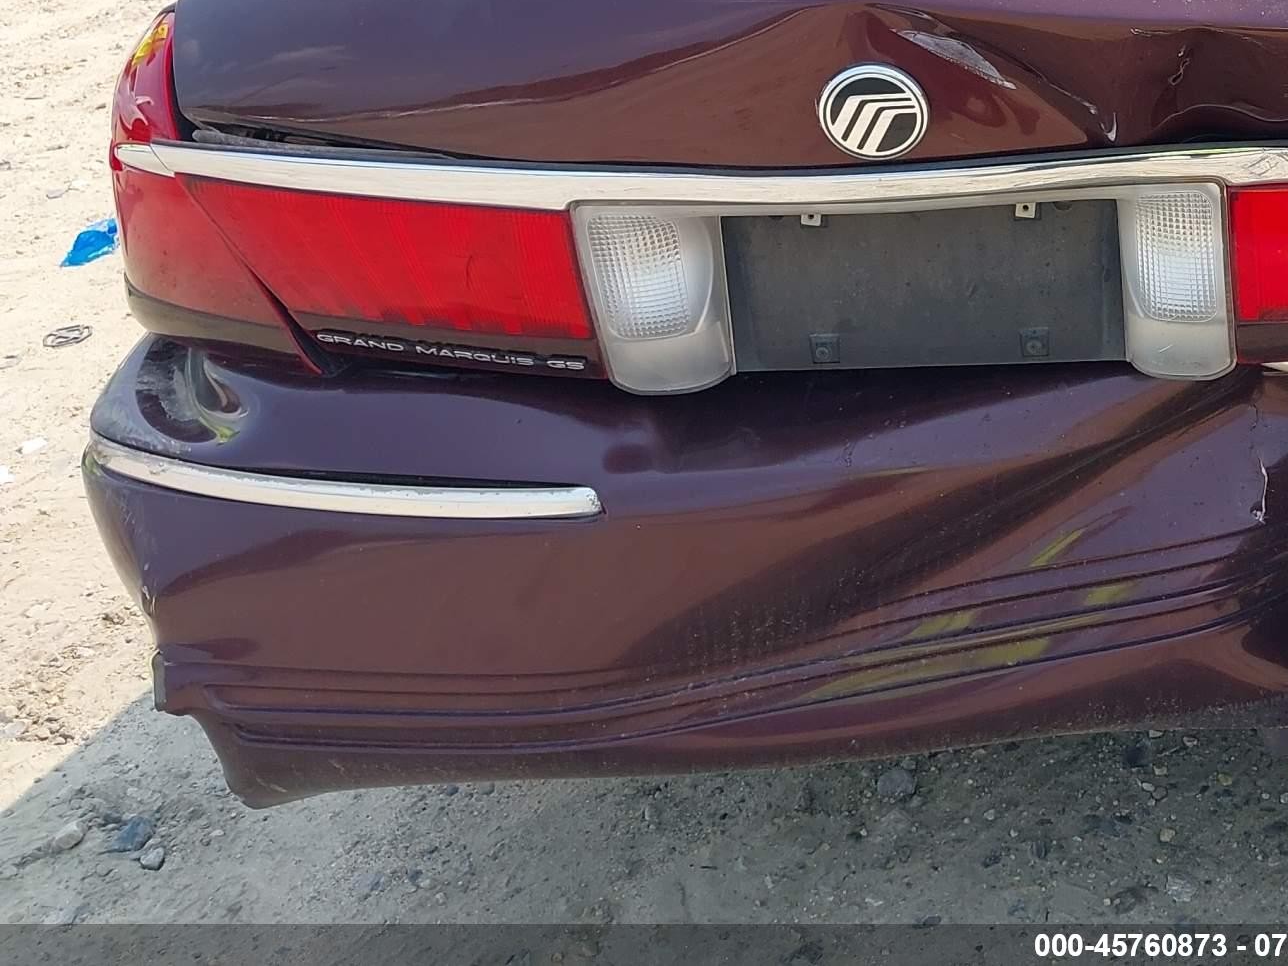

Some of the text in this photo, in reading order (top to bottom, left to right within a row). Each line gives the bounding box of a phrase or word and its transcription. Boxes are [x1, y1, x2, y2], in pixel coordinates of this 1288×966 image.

[316, 333, 586, 371] GRAND MARQUIS GS
